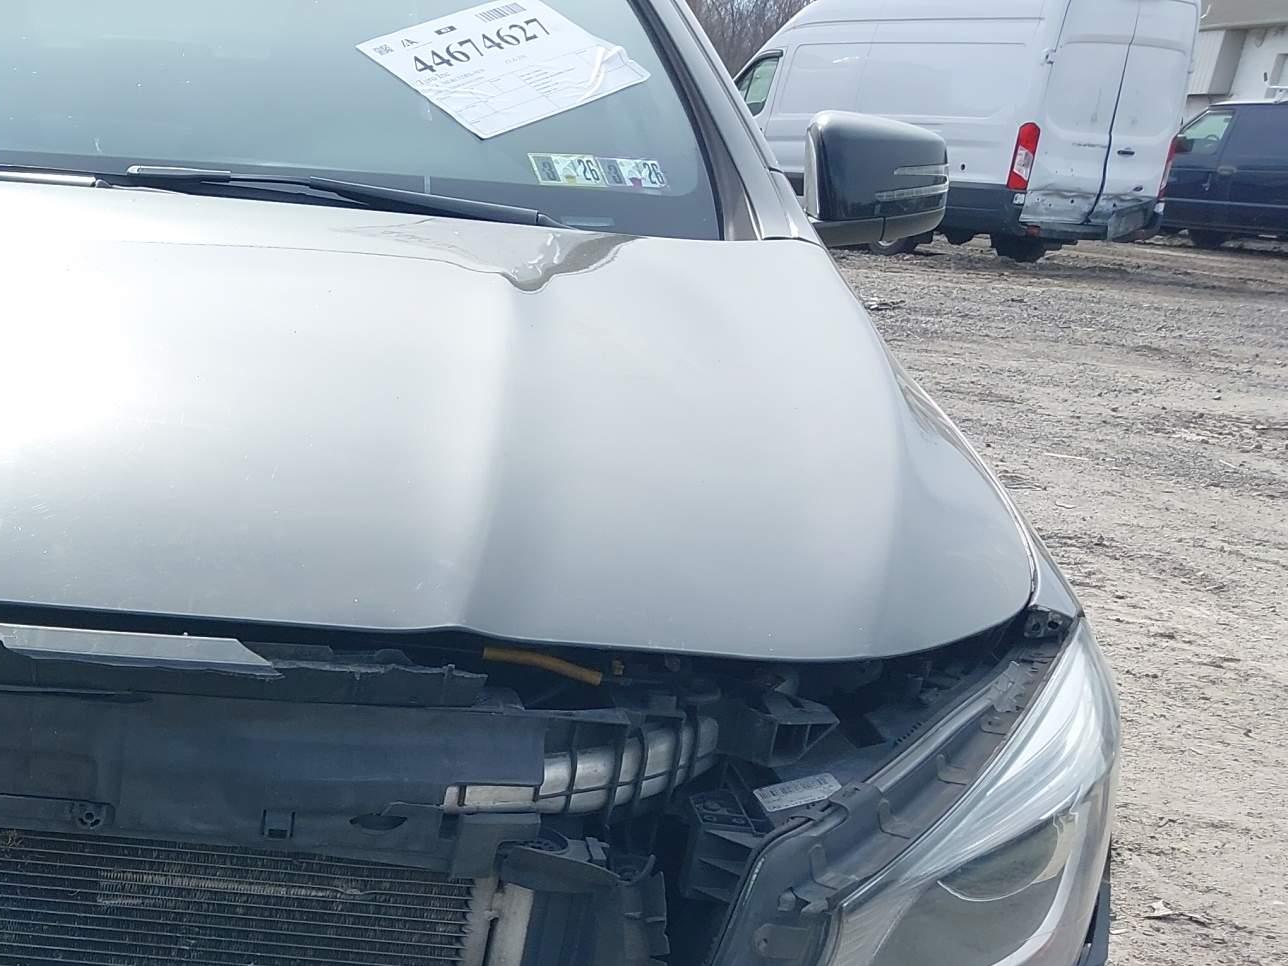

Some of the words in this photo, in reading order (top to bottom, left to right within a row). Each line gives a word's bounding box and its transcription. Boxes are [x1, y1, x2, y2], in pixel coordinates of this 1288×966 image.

[413, 18, 550, 73] 44674627
[542, 161, 557, 181] 3
[577, 159, 600, 181] 26
[608, 164, 623, 184] 3
[643, 162, 664, 185] 26
